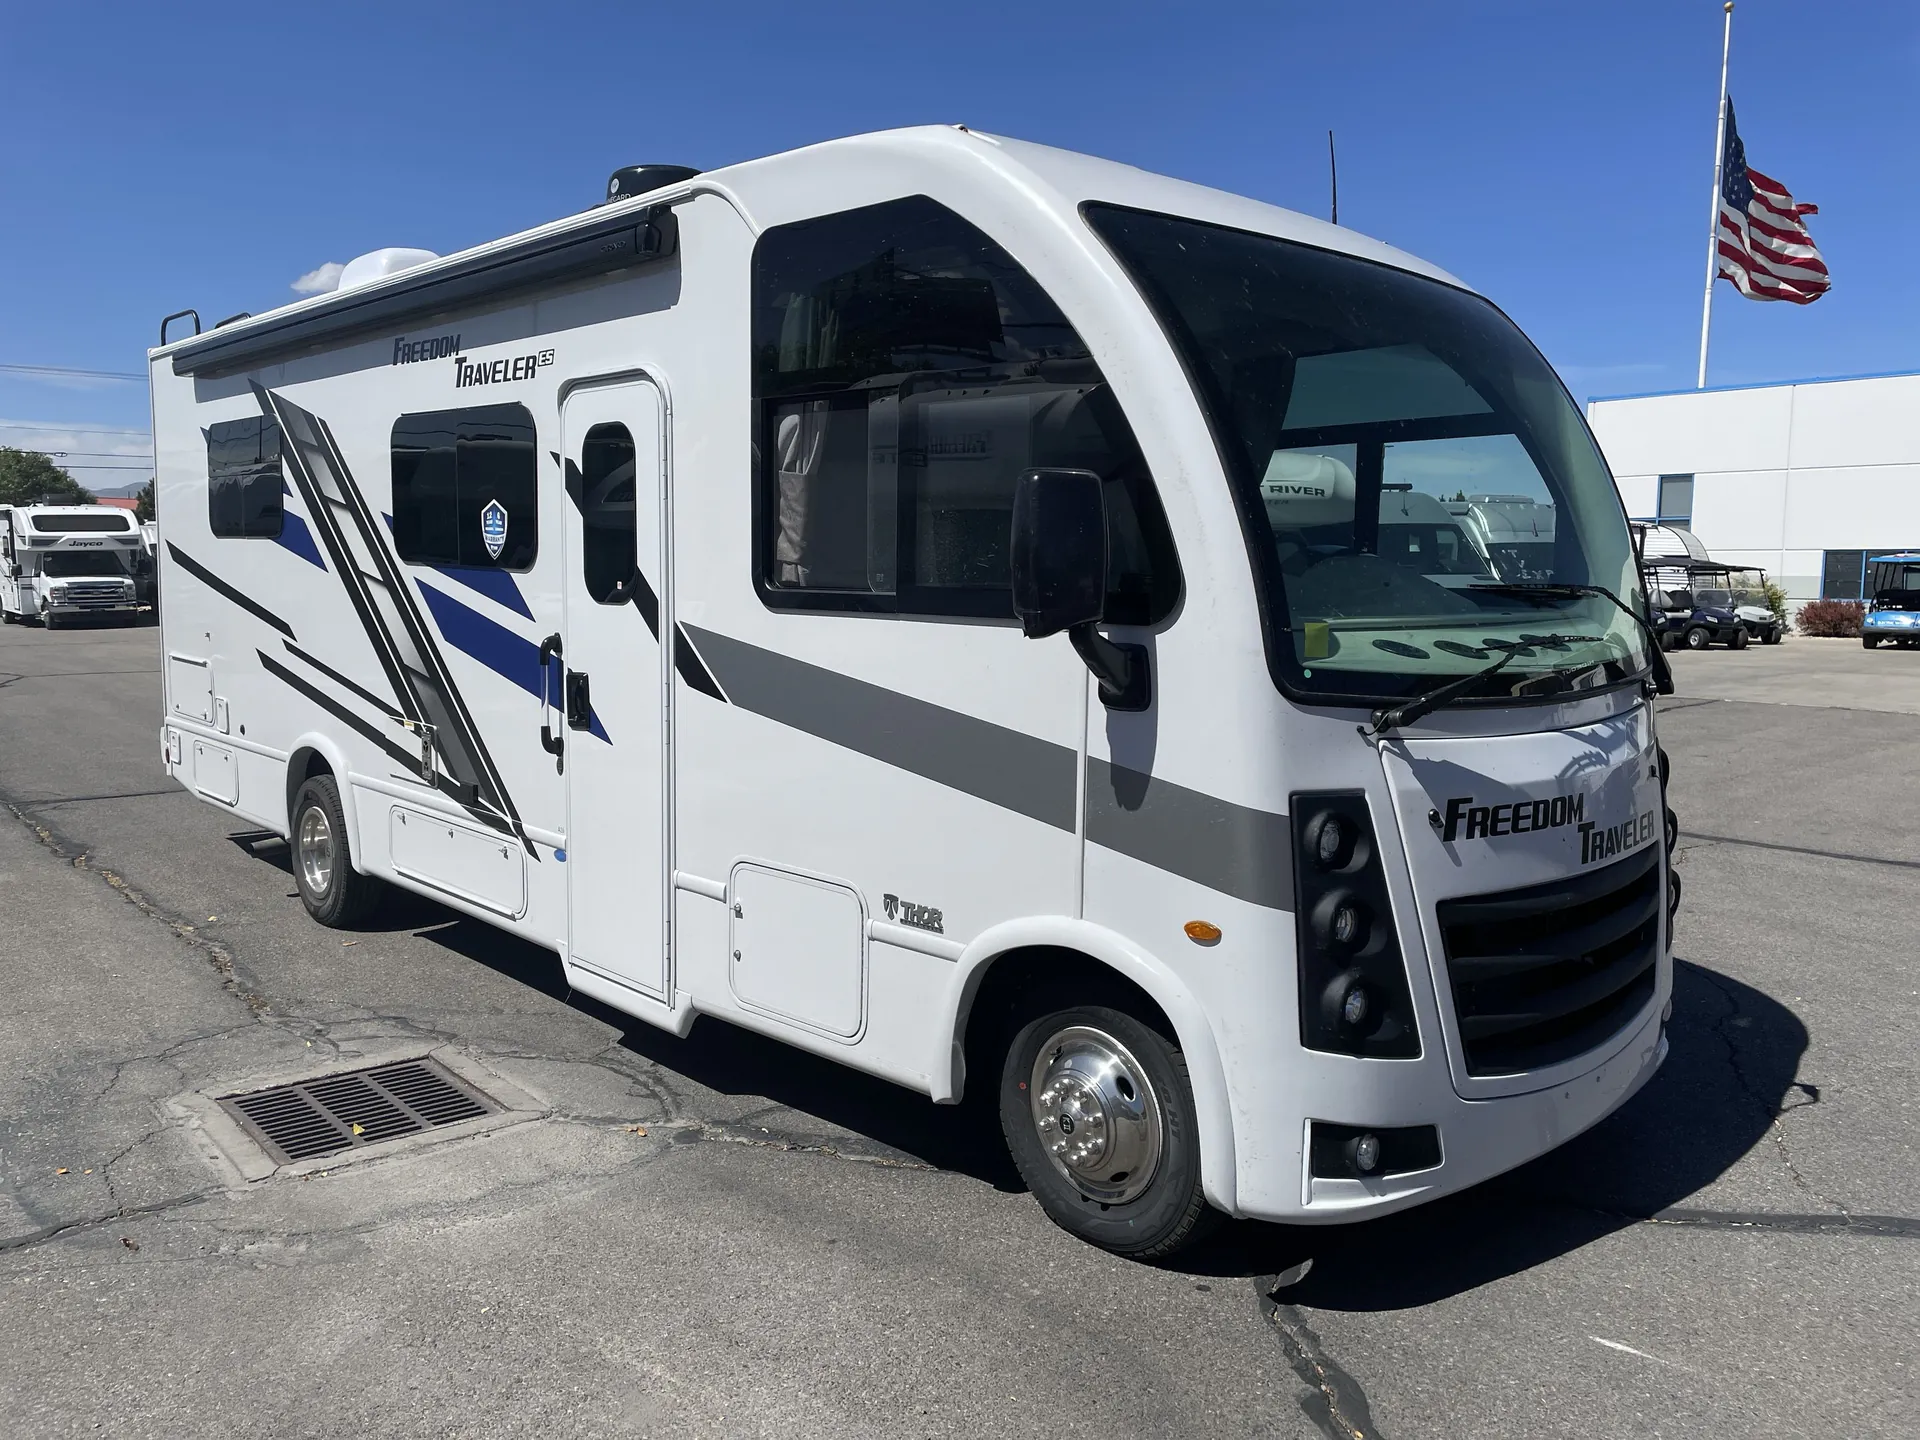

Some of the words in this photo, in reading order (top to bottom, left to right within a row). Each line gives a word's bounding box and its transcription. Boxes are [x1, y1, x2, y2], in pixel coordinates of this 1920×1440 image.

[393, 334, 461, 365] FREEDOM
[455, 356, 537, 388] TRAVELER
[538, 349, 555, 367] ES
[1269, 485, 1326, 497] RIVER
[68, 540, 104, 548] Jayco
[1443, 793, 1584, 842] FREEDOM
[1577, 810, 1655, 864] TRAVELER
[900, 900, 943, 929] THOR
